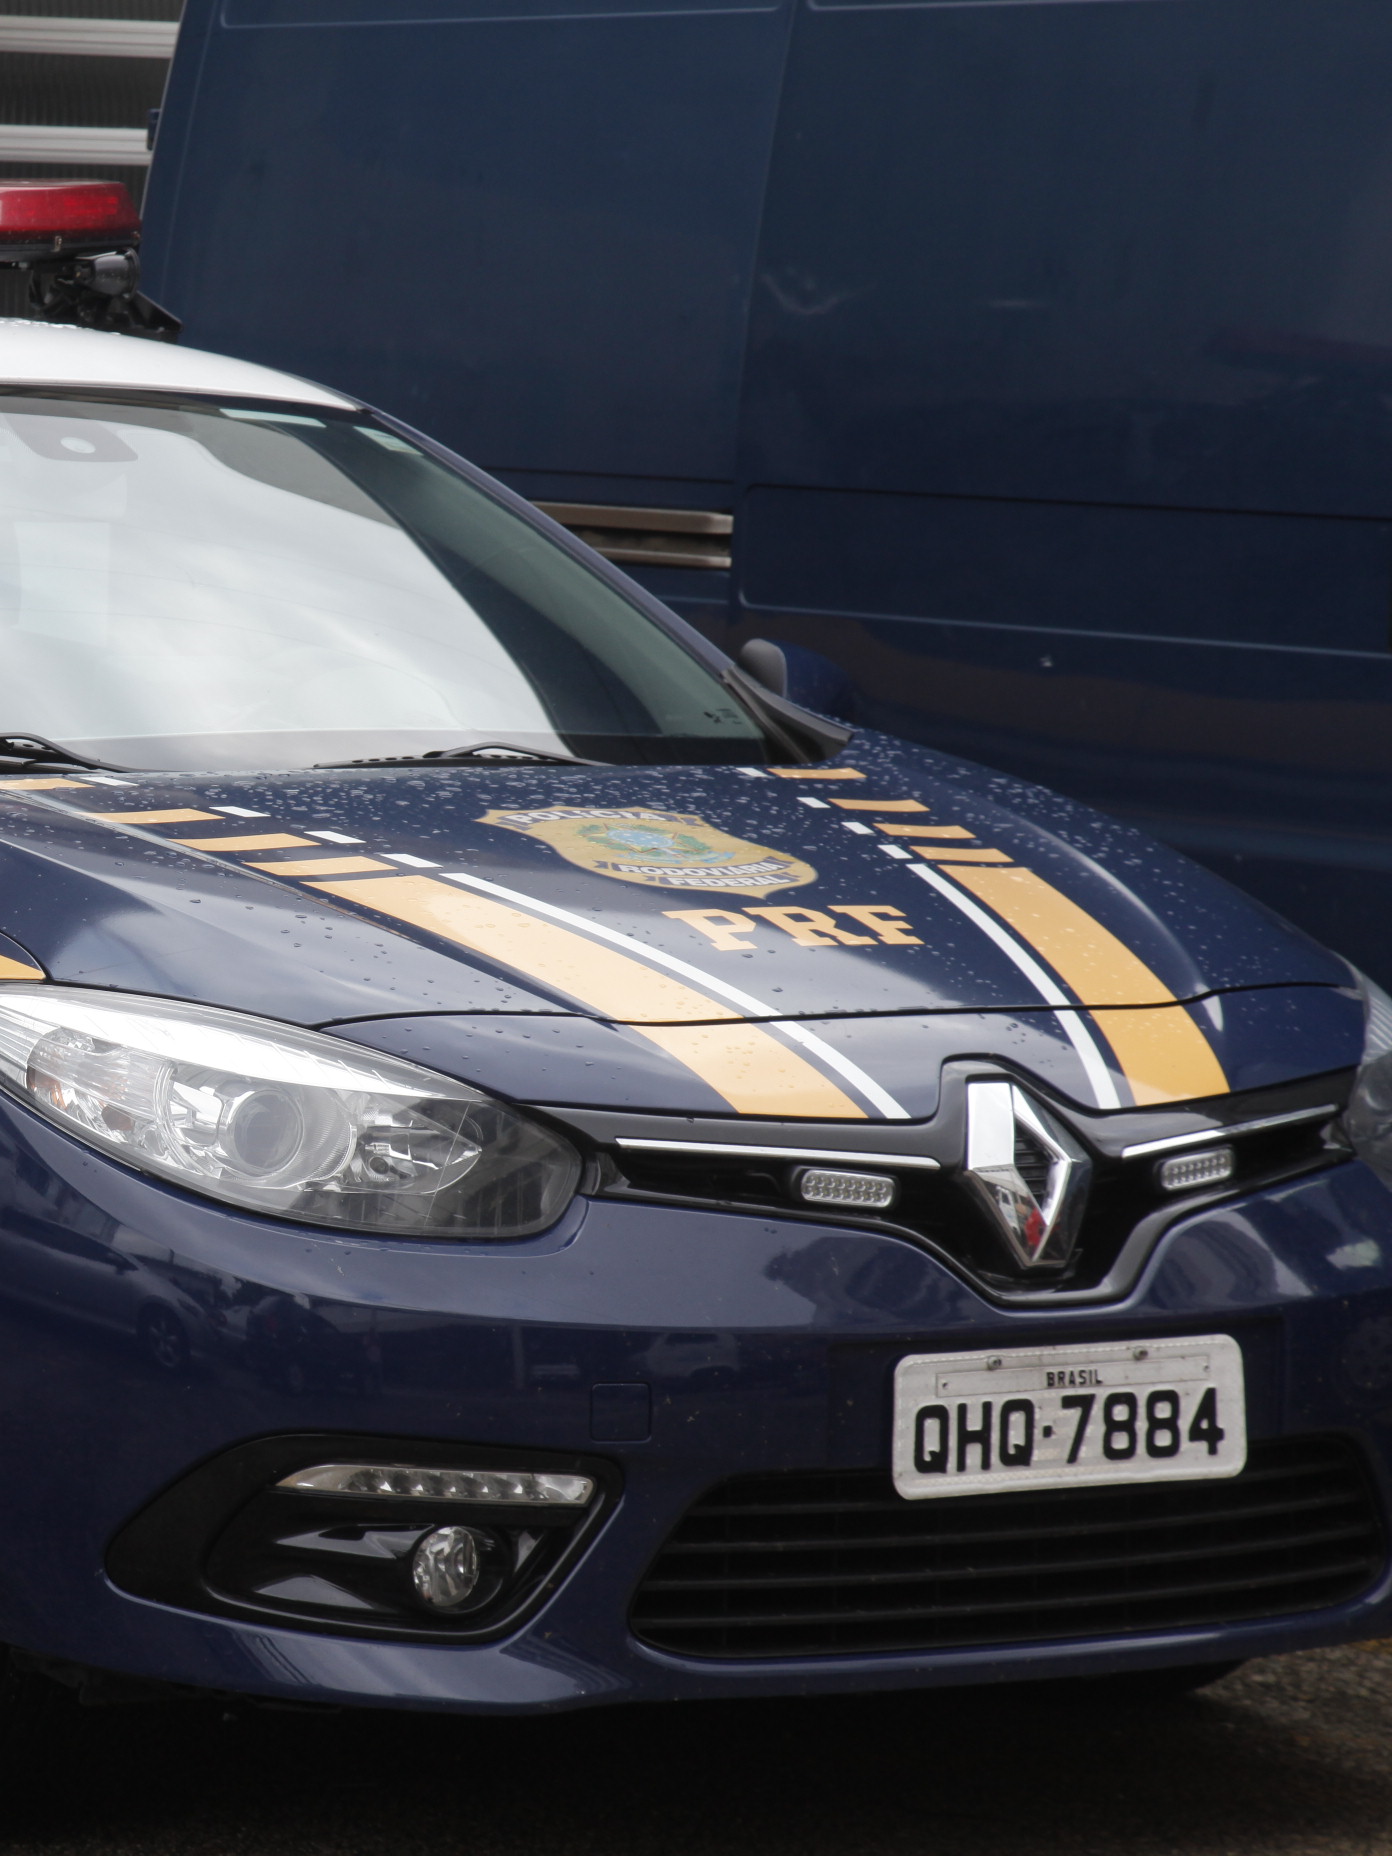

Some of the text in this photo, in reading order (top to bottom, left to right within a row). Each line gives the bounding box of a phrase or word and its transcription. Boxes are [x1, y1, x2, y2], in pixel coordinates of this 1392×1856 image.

[666, 875, 790, 887] FEDERAL
[662, 905, 925, 951] PRF
[1046, 1369, 1104, 1388] BRASIL
